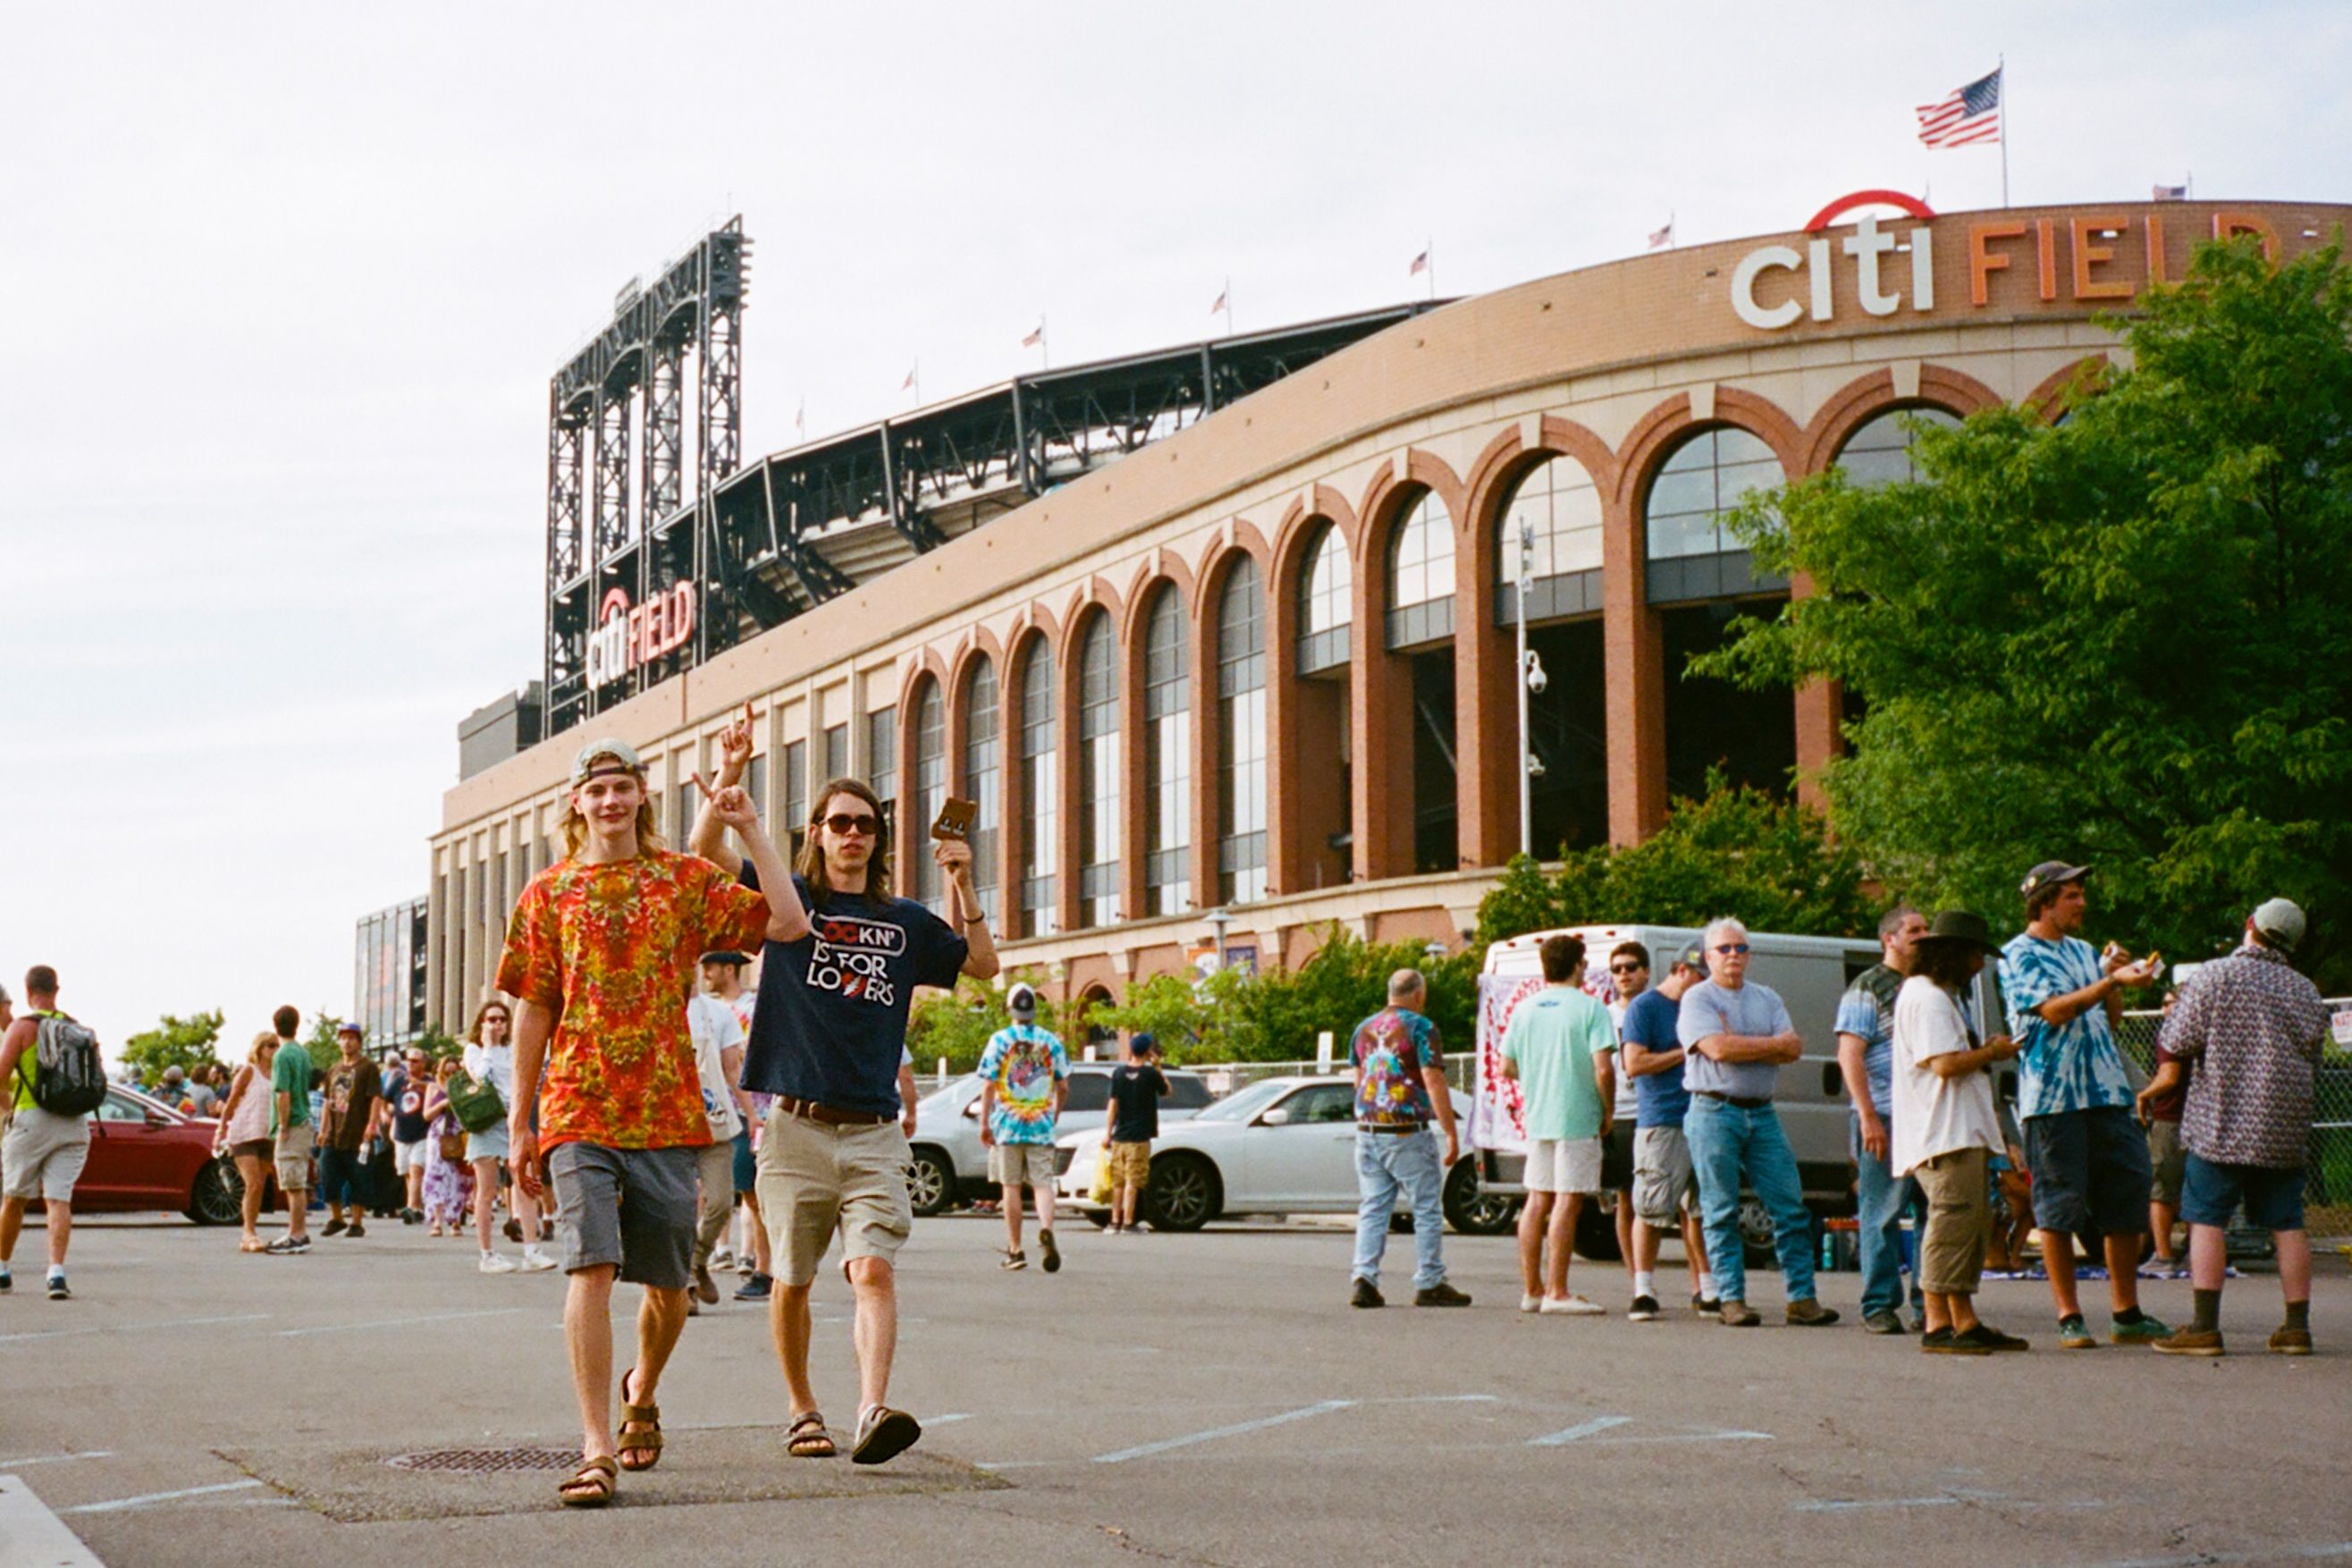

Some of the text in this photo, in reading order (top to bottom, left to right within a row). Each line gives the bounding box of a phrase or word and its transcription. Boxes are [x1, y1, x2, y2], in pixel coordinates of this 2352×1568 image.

[1731, 213, 1934, 329] citi
[628, 581, 694, 670] FIELD
[813, 940, 888, 979] IS FOR
